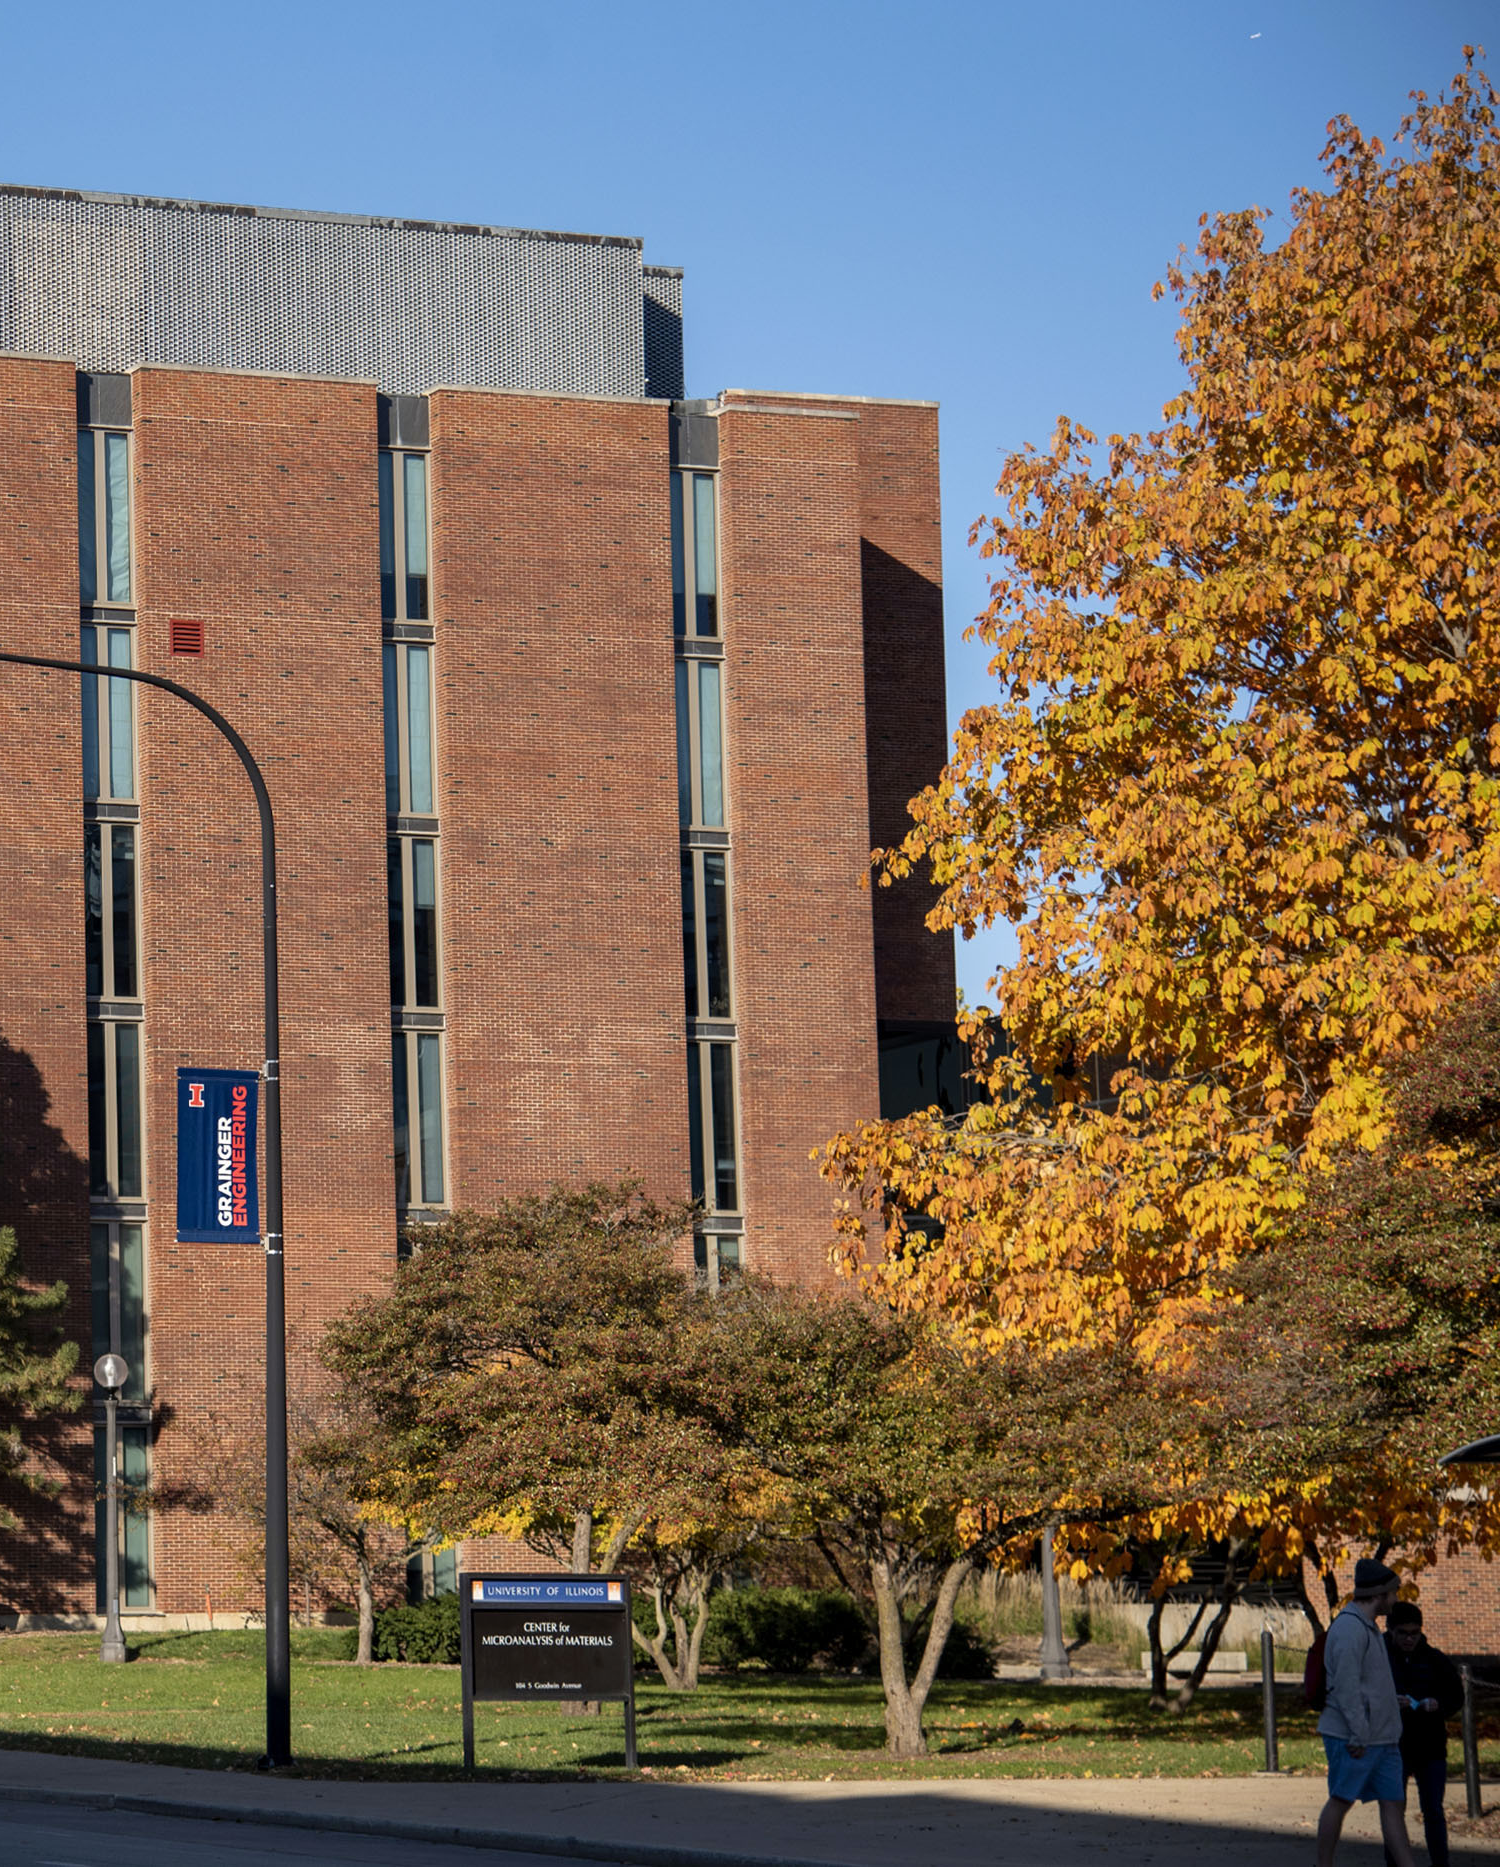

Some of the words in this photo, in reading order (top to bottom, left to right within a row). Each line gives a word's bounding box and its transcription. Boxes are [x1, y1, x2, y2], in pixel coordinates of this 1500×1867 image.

[232, 1085, 248, 1226] ENGINEERING
[218, 1117, 232, 1227] GRAINGER
[487, 1586, 541, 1596] UNIVERSITY
[546, 1587, 560, 1596] OF
[565, 1587, 605, 1596] ILLINOIS
[523, 1622, 557, 1632] CENTER
[559, 1622, 571, 1632] for
[482, 1635, 553, 1646] MICROANALYSIS
[555, 1635, 564, 1645] of
[565, 1636, 613, 1646] MATERIALS
